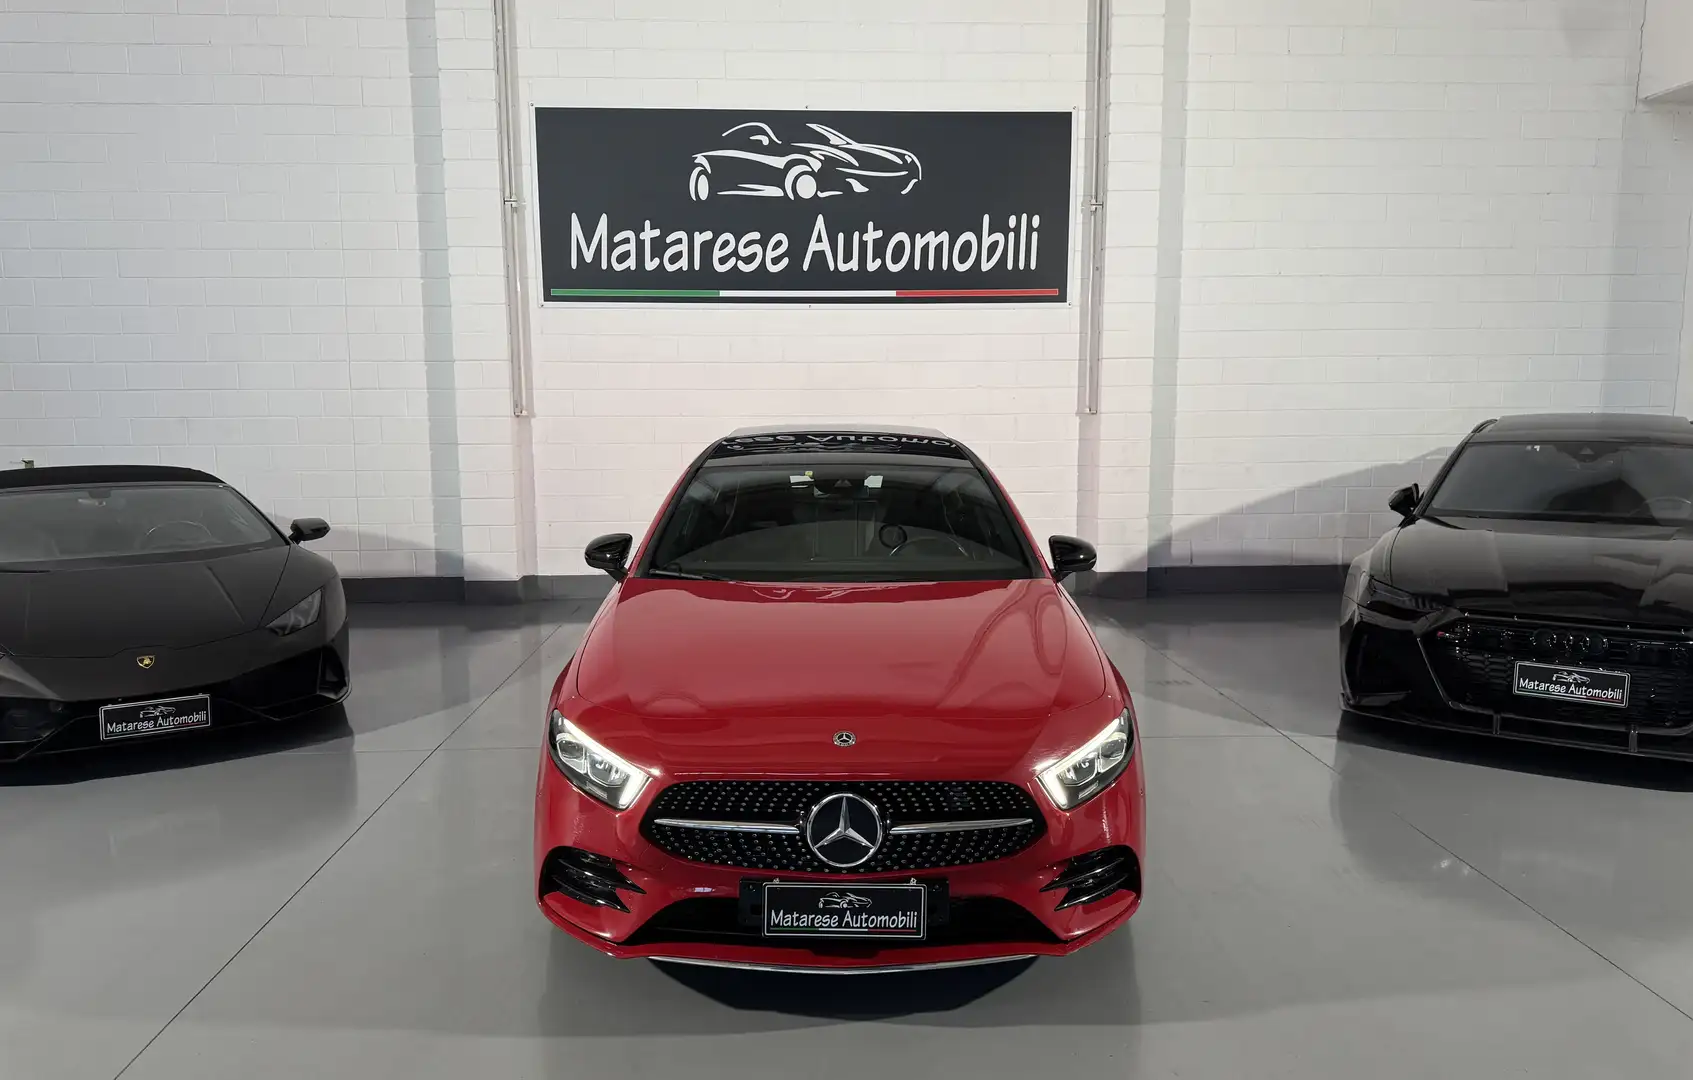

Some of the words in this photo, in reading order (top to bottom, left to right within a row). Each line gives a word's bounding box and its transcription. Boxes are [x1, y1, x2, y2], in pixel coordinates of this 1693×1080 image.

[570, 212, 789, 273] Matarese
[803, 213, 1041, 273] Automobili
[1519, 678, 1566, 693] Matarese
[1568, 684, 1622, 700] Automobili
[107, 720, 154, 733] Matarese
[157, 711, 206, 726] Automobili
[770, 909, 839, 928] Matarese
[842, 910, 918, 929] Automobili
